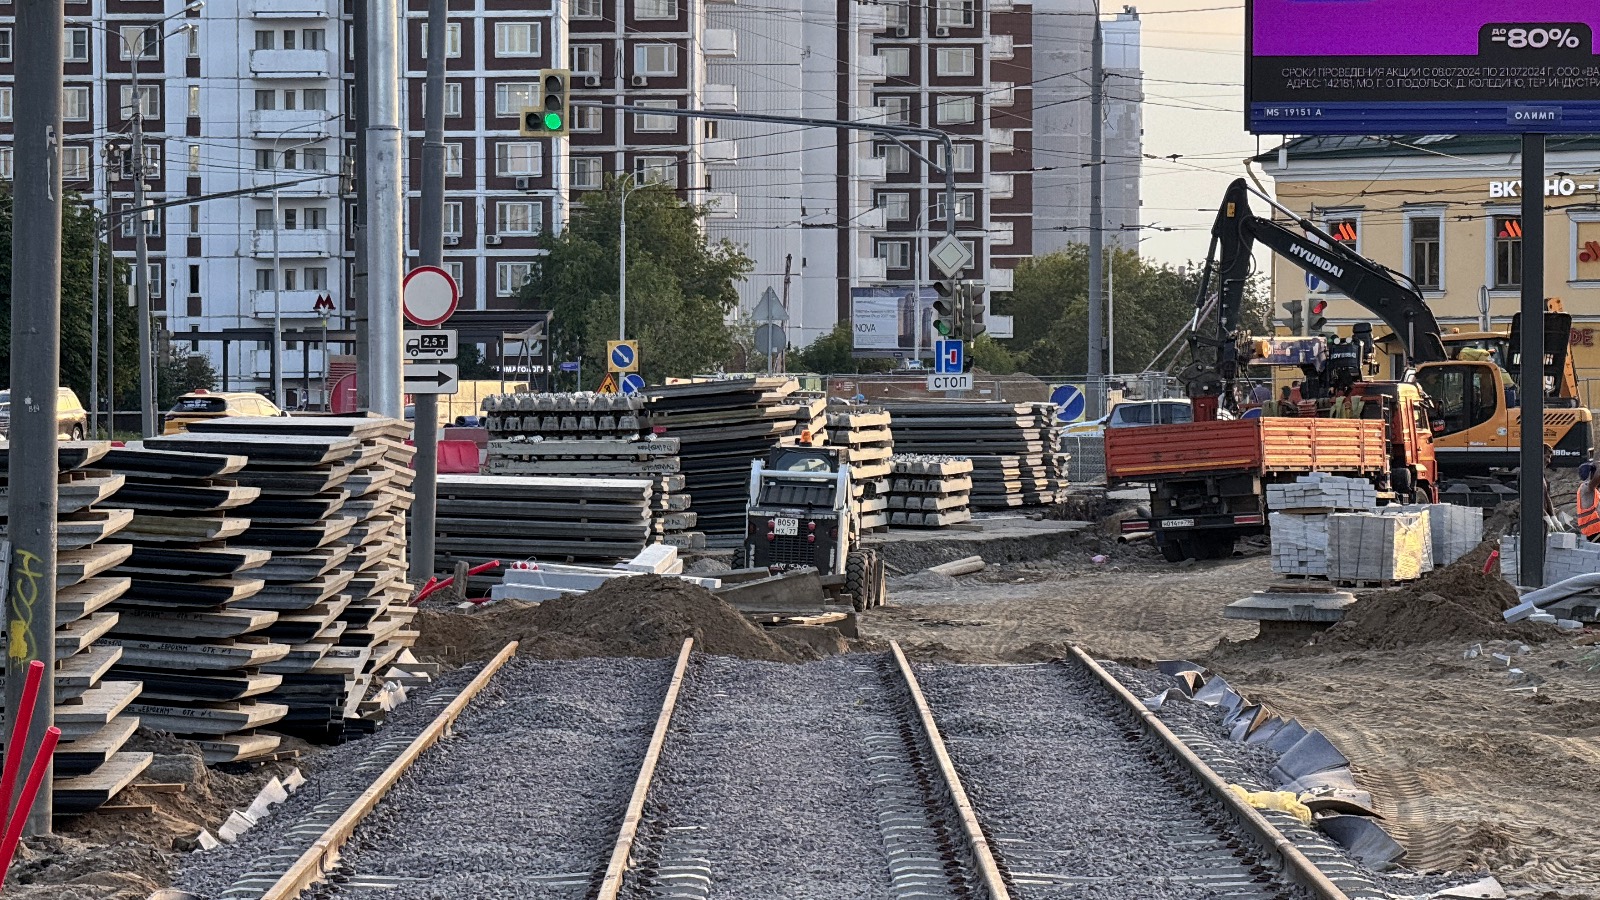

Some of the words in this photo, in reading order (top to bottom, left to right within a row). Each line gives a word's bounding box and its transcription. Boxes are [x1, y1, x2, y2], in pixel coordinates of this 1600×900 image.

[1281, 67, 1317, 78] СРОКИ
[1318, 67, 1384, 79] ПРОВЕДЕНИЯ
[1386, 67, 1420, 78] АКЦИИ
[1482, 67, 1498, 77] ПО
[1556, 66, 1580, 77] ООО
[1266, 108, 1280, 117] MS
[1284, 108, 1311, 117] 19151
[1514, 111, 1555, 120] ОЛИМП
[1489, 178, 1576, 198] ВКНО
[1289, 243, 1344, 278] HYUNDAI
[855, 323, 877, 333] NOVA
[423, 337, 438, 347] 2,5
[933, 376, 968, 389] СТОП
